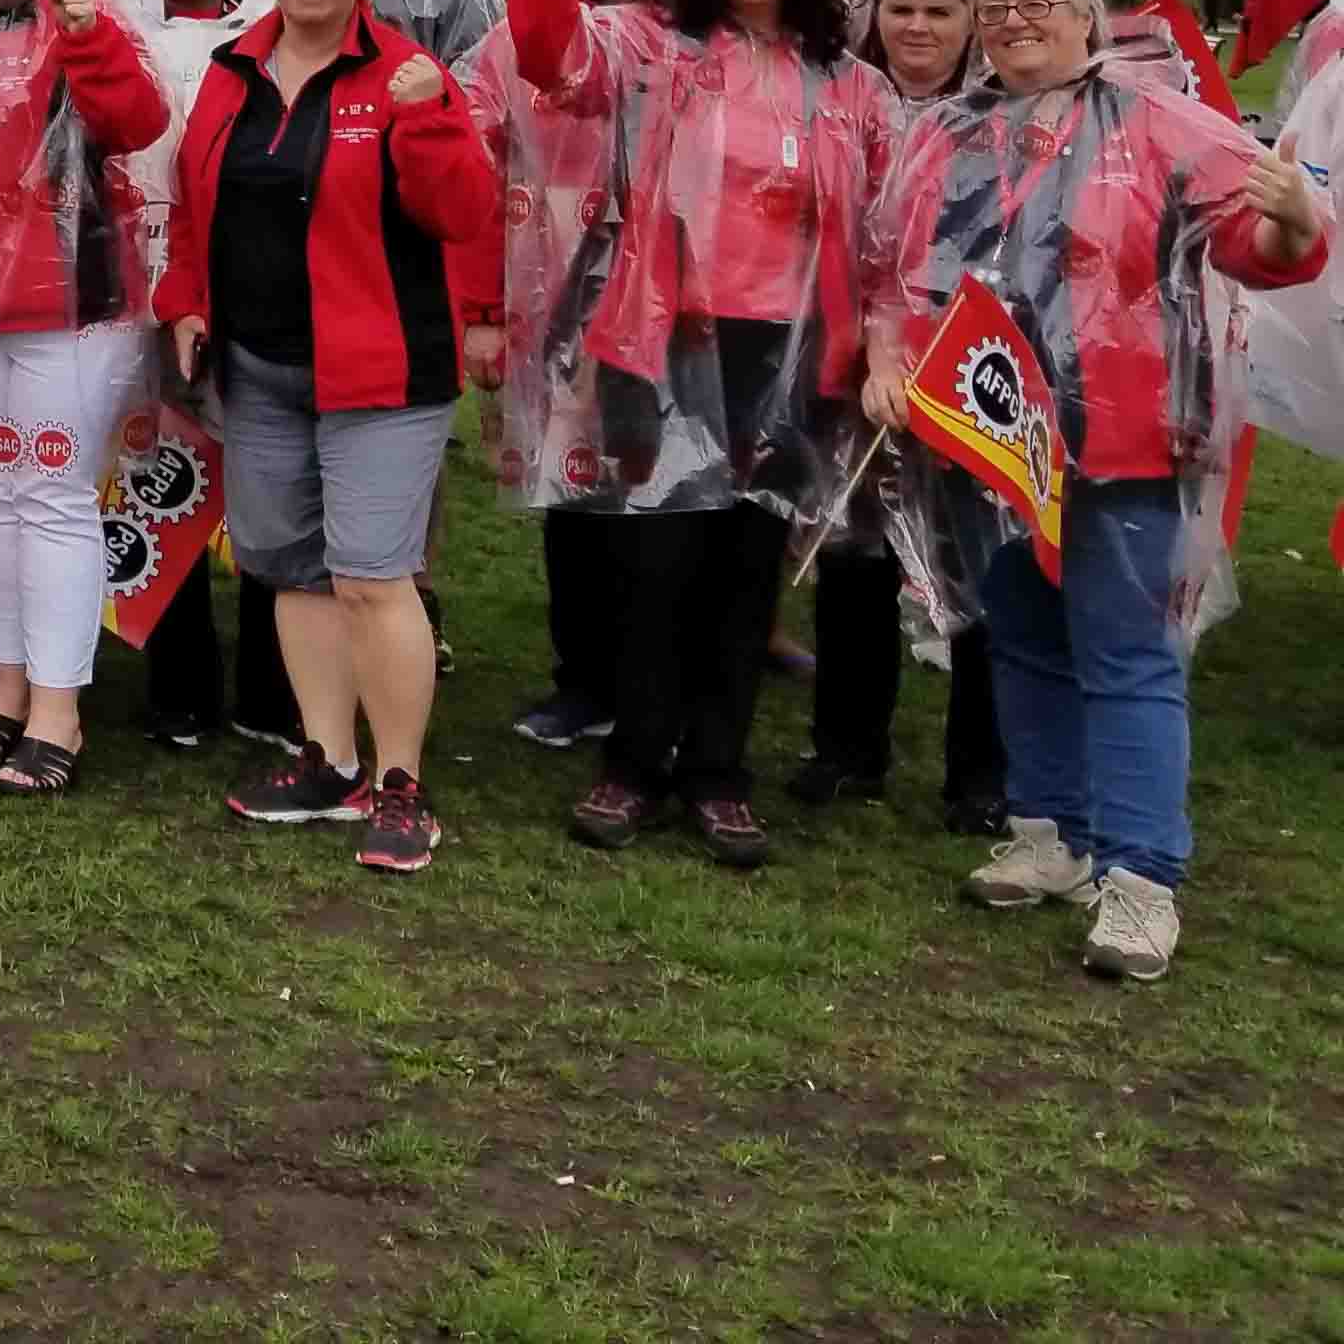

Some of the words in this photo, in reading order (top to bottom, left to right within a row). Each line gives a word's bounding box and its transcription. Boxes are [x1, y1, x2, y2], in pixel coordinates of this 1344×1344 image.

[976, 364, 1019, 419] AFPC
[38, 441, 70, 457] AFPC
[139, 449, 183, 506] AFPC
